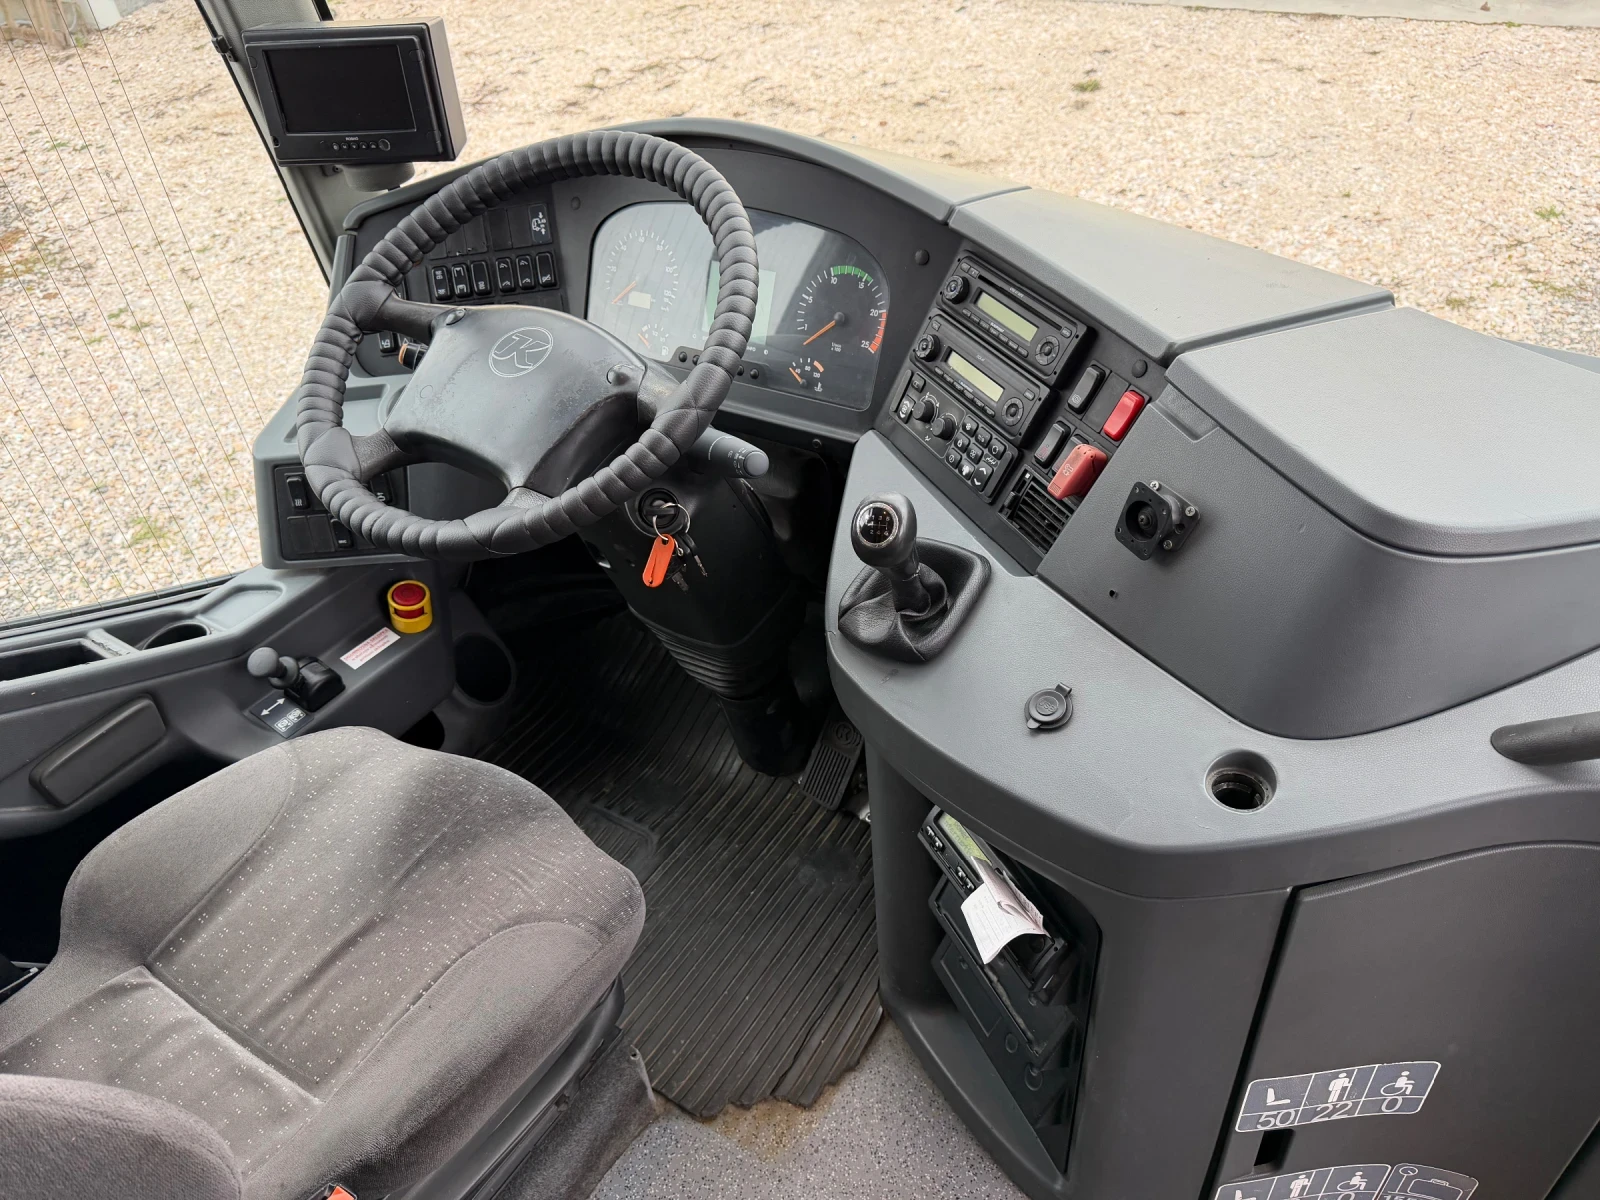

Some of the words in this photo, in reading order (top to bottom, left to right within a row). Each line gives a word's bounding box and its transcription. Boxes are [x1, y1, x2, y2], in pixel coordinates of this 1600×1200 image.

[830, 276, 838, 285] 10
[807, 296, 813, 304] 5
[869, 309, 879, 317] 20
[860, 340, 870, 349] 25
[1037, 698, 1056, 712] USB
[1256, 1109, 1296, 1130] 50
[1311, 1101, 1353, 1123] 22
[1380, 1096, 1402, 1113] 0
